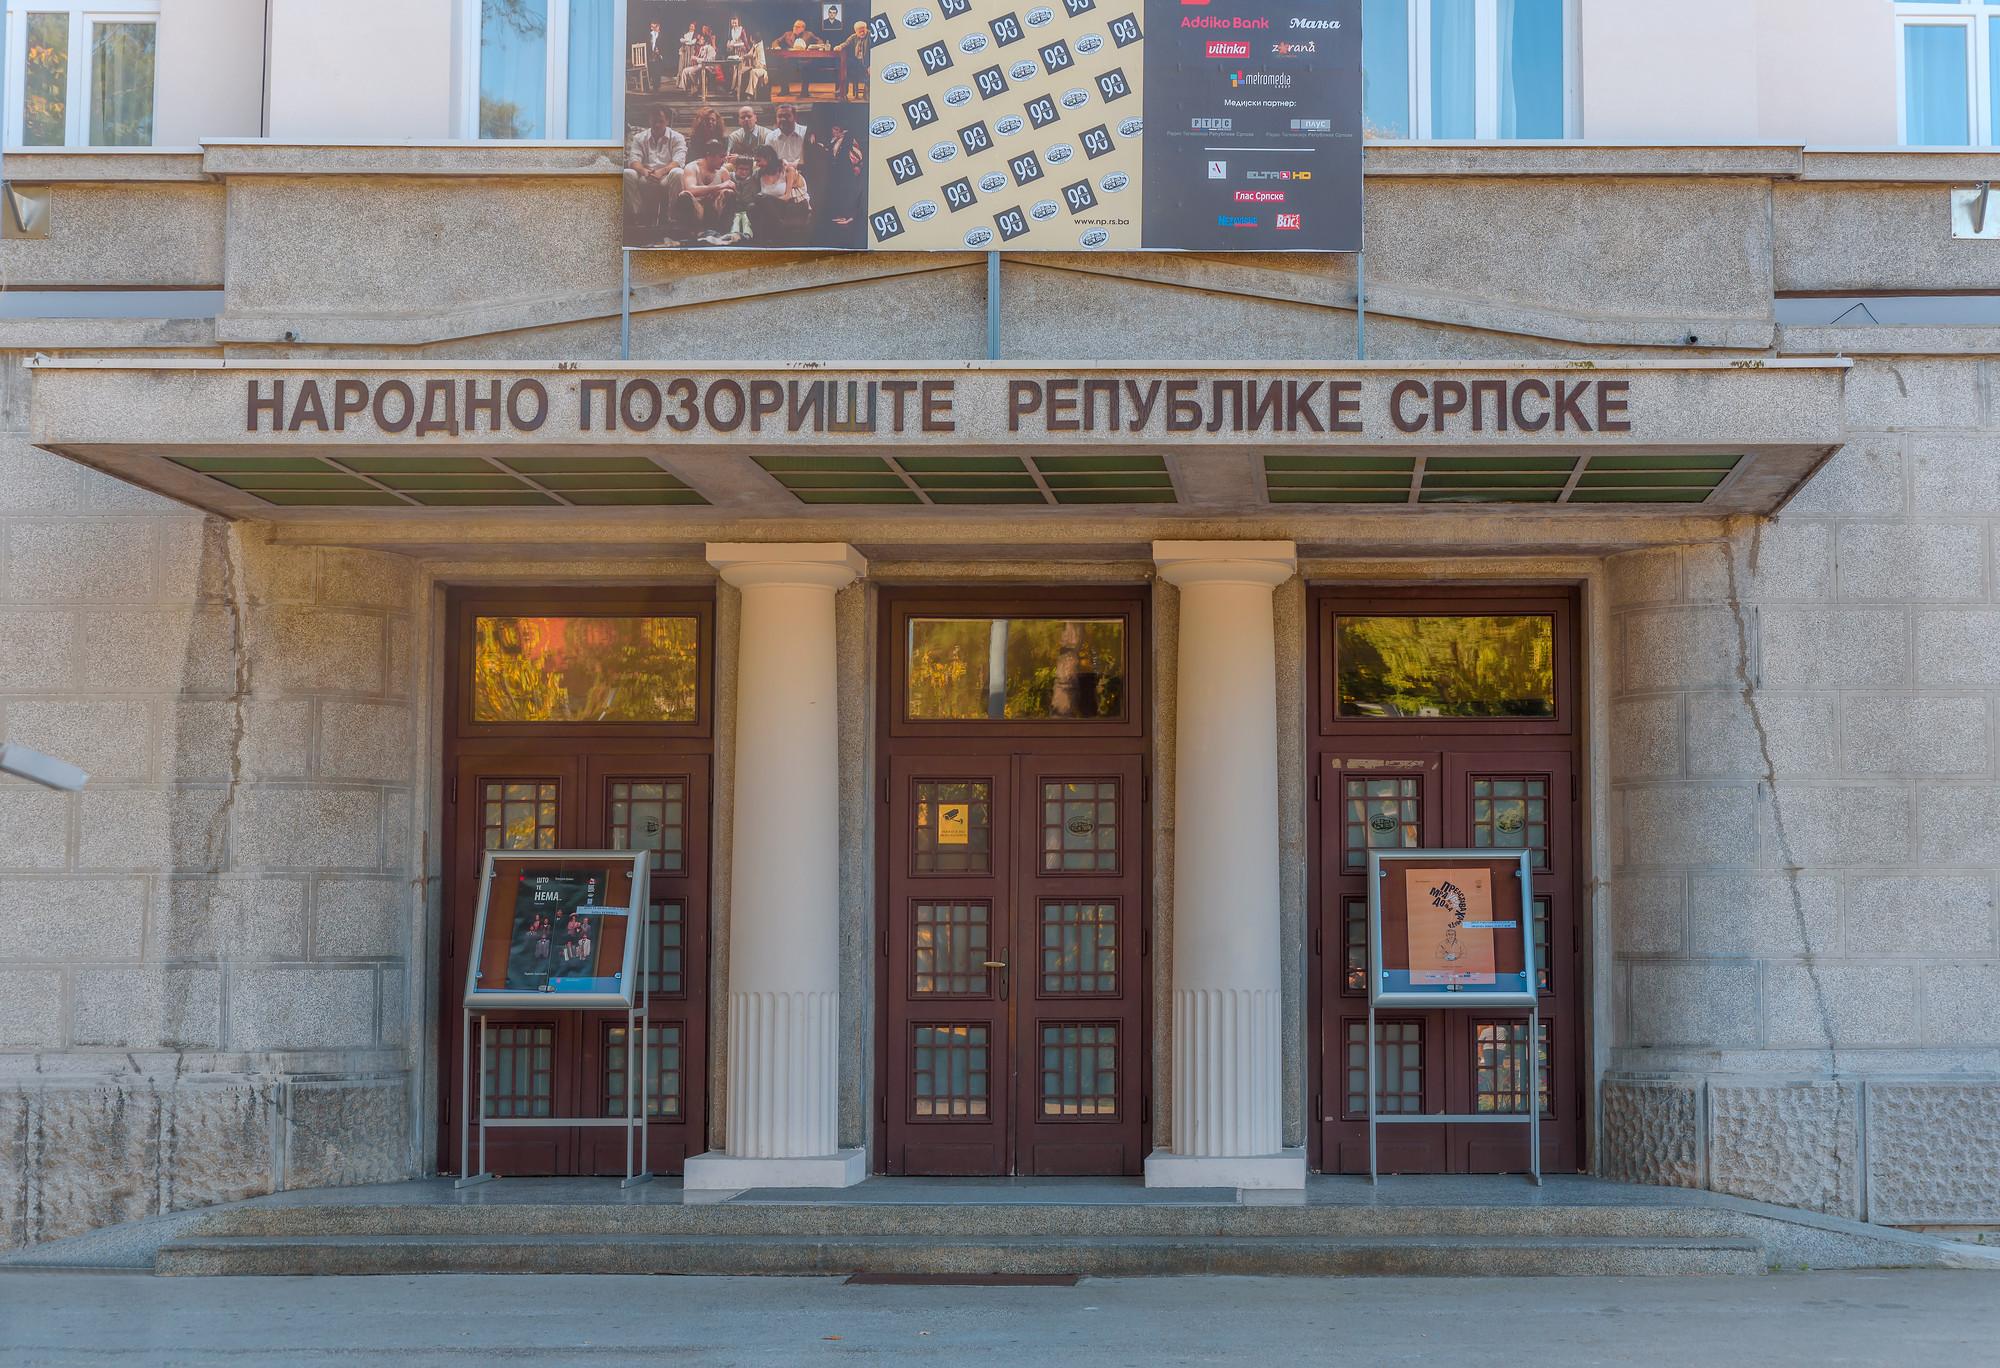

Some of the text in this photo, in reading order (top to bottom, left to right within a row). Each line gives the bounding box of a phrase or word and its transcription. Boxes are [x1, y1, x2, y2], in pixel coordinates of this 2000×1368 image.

[995, 18, 1018, 42] 90
[1113, 18, 1136, 42] 90
[1181, 17, 1269, 29] Addiko Bank
[1289, 18, 1341, 29] Мања
[924, 47, 947, 70] 90
[1045, 46, 1068, 69] 90
[1208, 43, 1247, 55] vitinka
[979, 71, 1002, 95] 90
[1101, 74, 1124, 97] 90
[1245, 72, 1291, 85] metromedia
[909, 101, 932, 125] 90
[1030, 100, 1053, 124] 90
[1224, 99, 1297, 109] Медијски партнер:
[1193, 119, 1230, 128] РТРС
[964, 127, 987, 151] 90
[1085, 131, 1108, 154] 90
[893, 156, 916, 179] 90
[1014, 157, 1037, 180] 90
[948, 183, 971, 207] 90
[1068, 185, 1091, 209] 90
[1235, 191, 1284, 202] Глас Српске
[874, 213, 898, 236] 90
[1000, 212, 1023, 236] 90
[1074, 217, 1130, 226] www.np.rs.ba
[247, 378, 1632, 437] НАРОДНО ПОЗОРИШТЕ РЕПУБЛИКЕ СРПСКЕ
